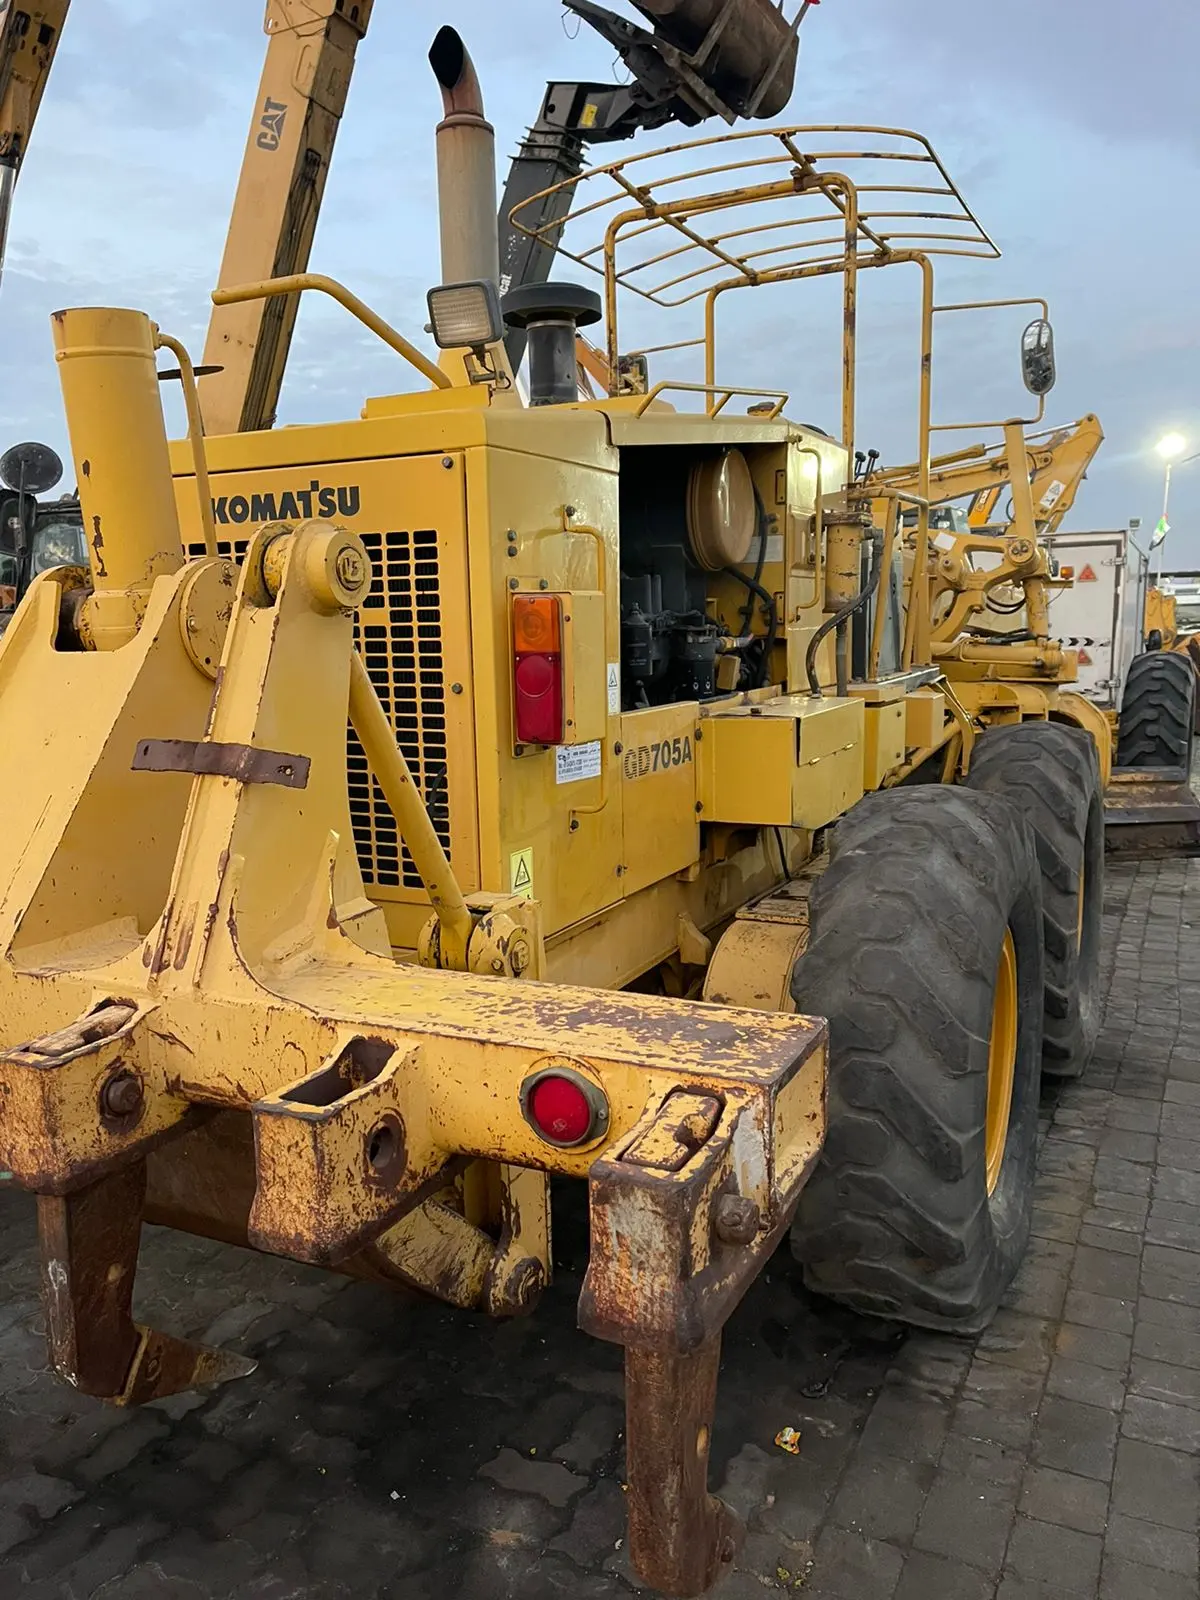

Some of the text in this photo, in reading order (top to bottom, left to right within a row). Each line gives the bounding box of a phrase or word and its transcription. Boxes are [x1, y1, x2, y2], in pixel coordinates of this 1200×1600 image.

[257, 97, 288, 151] CAT
[211, 480, 361, 525] KOMATSU
[624, 735, 692, 779] GD705A
